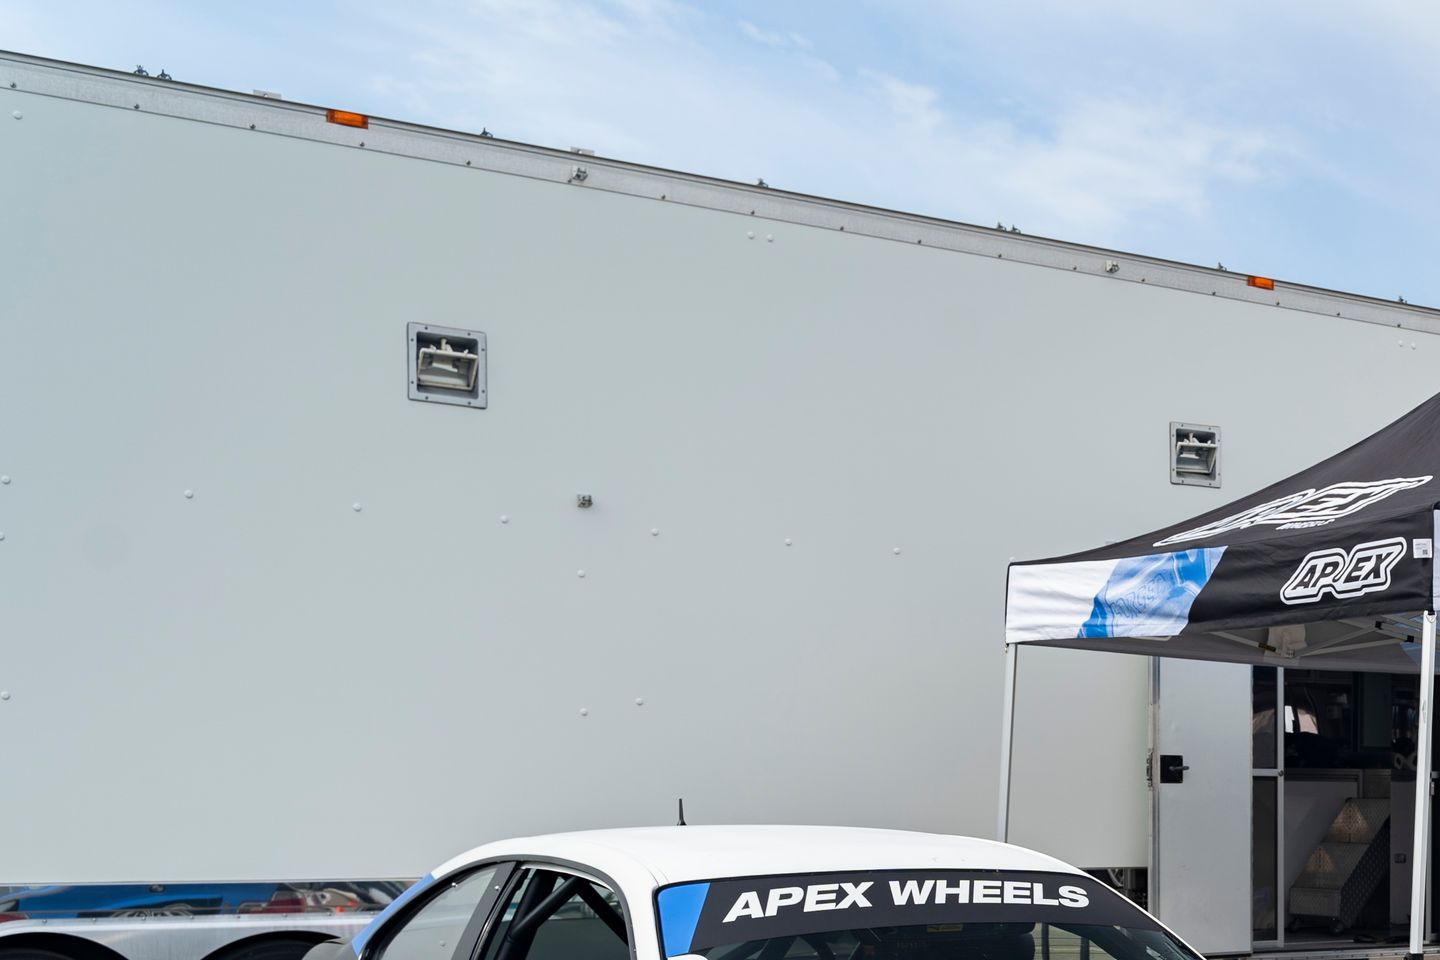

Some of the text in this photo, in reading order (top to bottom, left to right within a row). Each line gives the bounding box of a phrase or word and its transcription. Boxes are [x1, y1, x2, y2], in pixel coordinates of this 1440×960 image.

[1288, 546, 1399, 598] APEX
[722, 880, 1090, 923] APEX WHEELS
